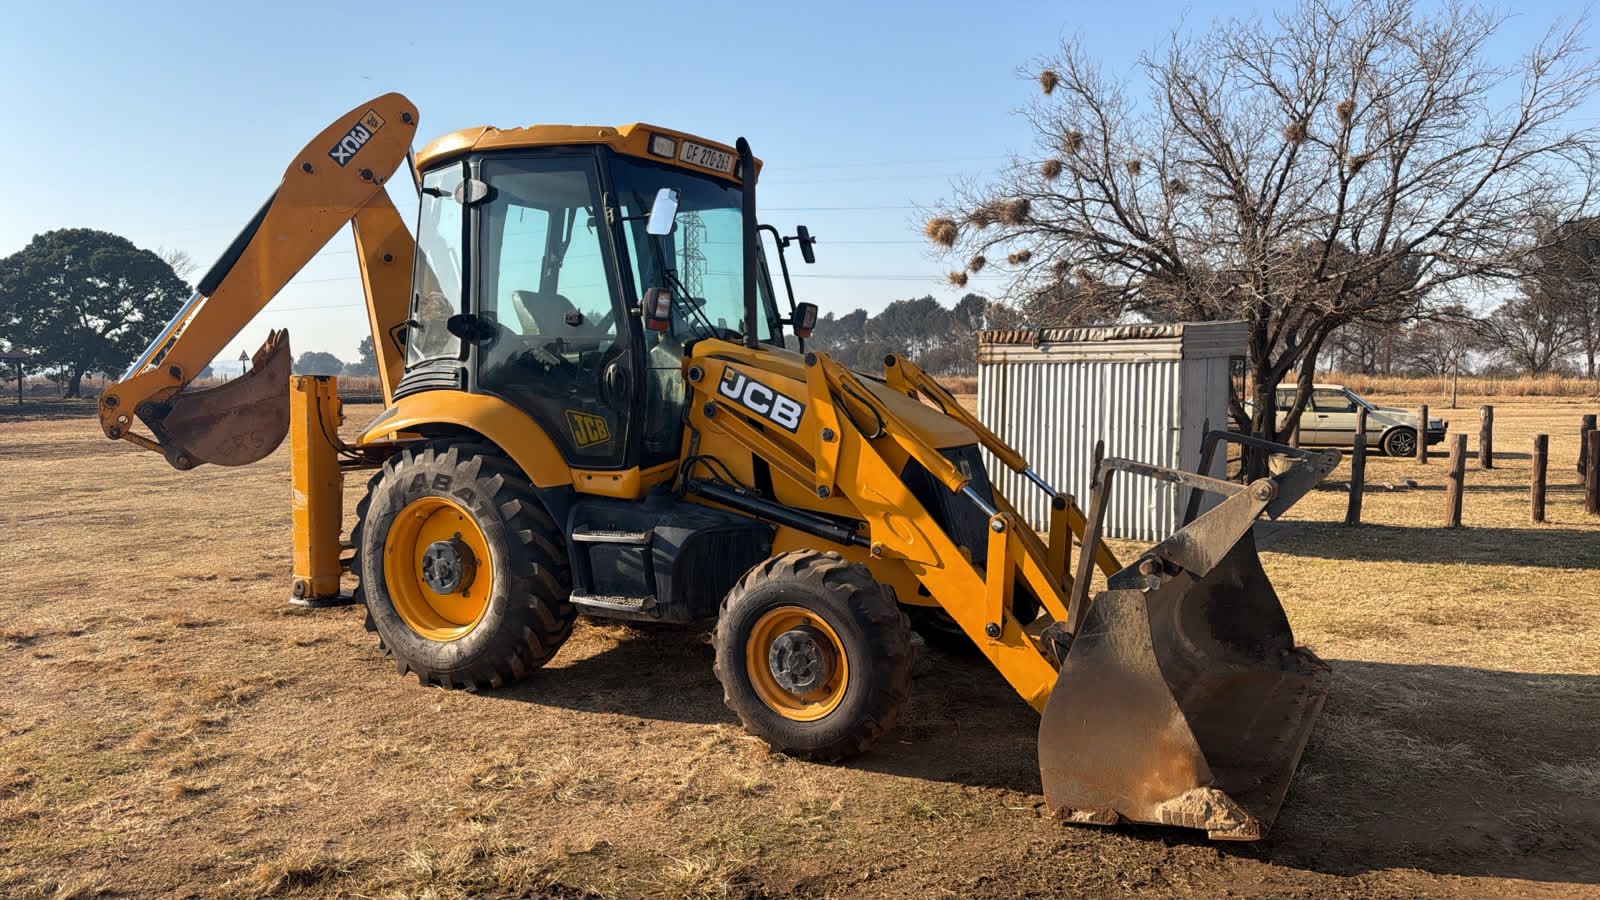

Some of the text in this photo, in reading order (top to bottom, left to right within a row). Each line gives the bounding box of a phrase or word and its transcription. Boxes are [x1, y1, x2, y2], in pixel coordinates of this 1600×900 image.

[331, 125, 370, 165] 3CX
[686, 144, 699, 161] CF
[720, 375, 802, 429] JCB
[573, 414, 608, 443] JCB
